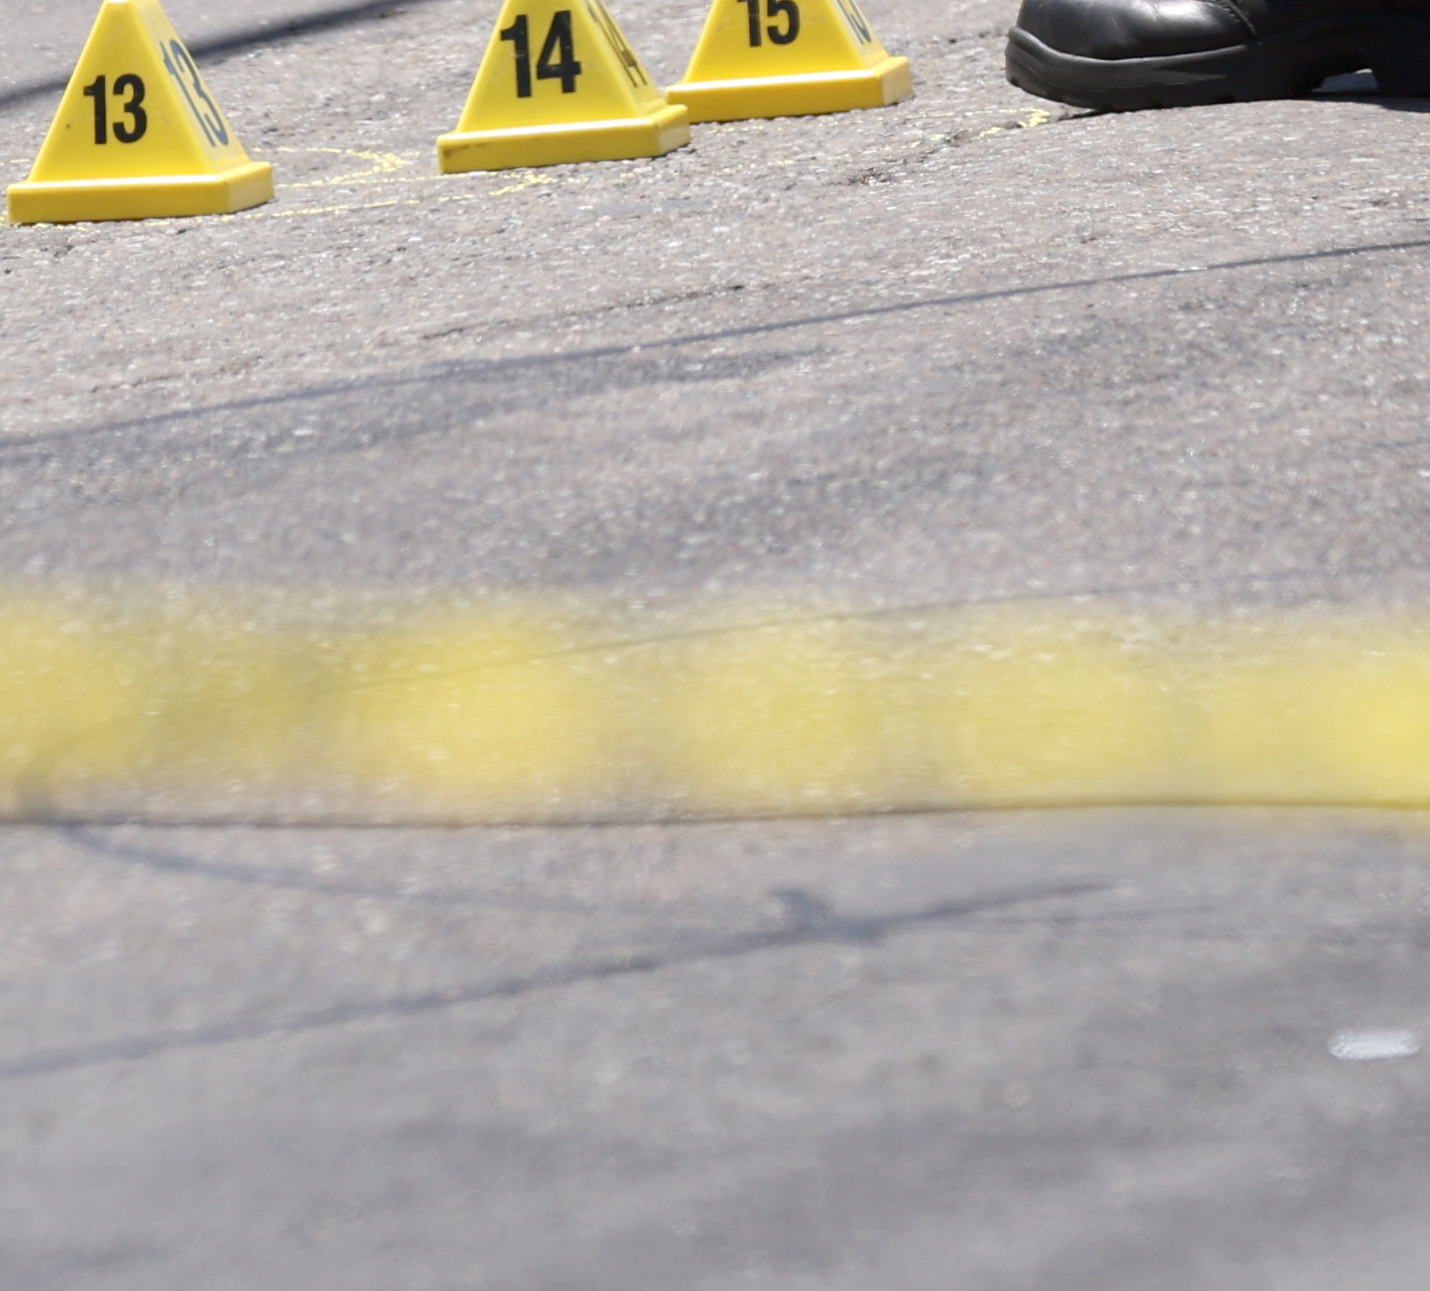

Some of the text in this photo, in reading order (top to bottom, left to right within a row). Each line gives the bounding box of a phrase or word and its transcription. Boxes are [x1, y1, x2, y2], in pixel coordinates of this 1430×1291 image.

[159, 38, 230, 148] 13
[500, 9, 582, 98] 14
[83, 73, 148, 145] 13
